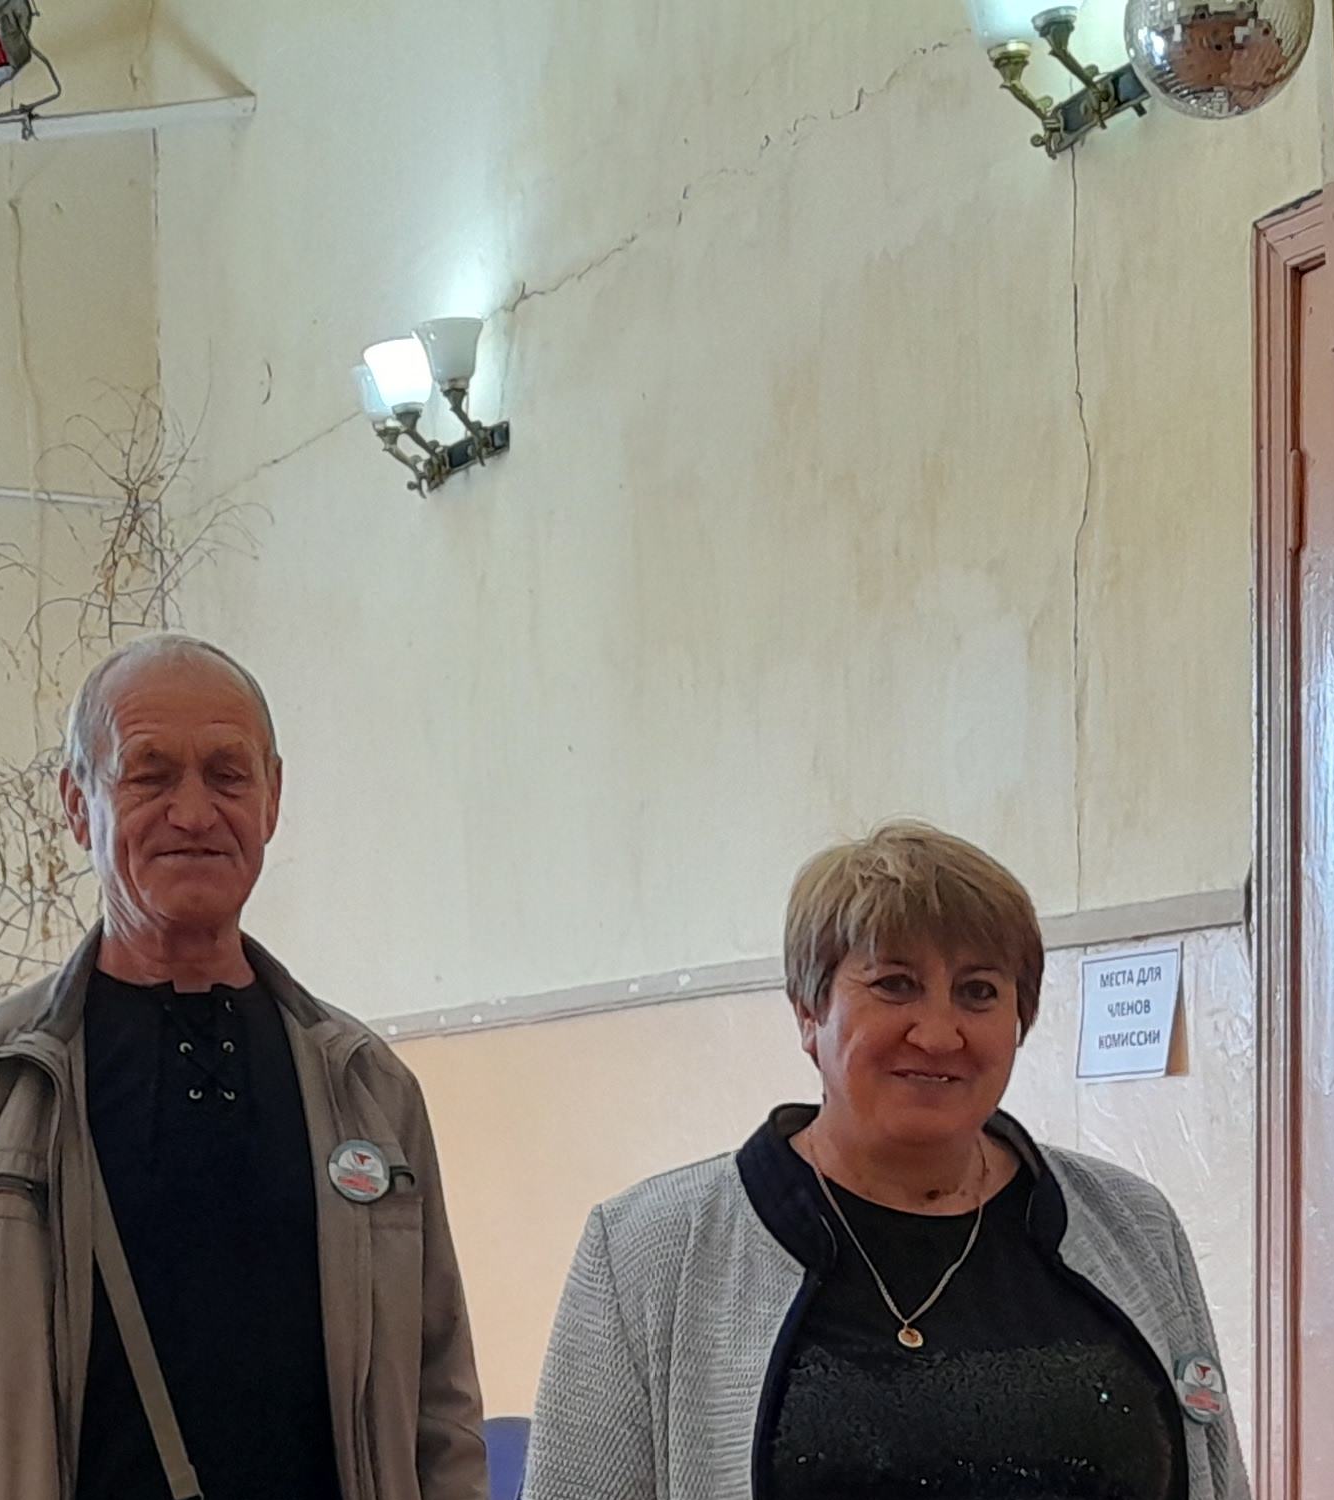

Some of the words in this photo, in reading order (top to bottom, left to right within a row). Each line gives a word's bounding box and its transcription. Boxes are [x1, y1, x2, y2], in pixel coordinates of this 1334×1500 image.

[1099, 968, 1135, 988] МЕСТА
[1136, 966, 1162, 987] ДЛЯ
[1107, 999, 1151, 1018] ЧЛЕНОВ
[1098, 1029, 1161, 1050] КОМИССИИ
